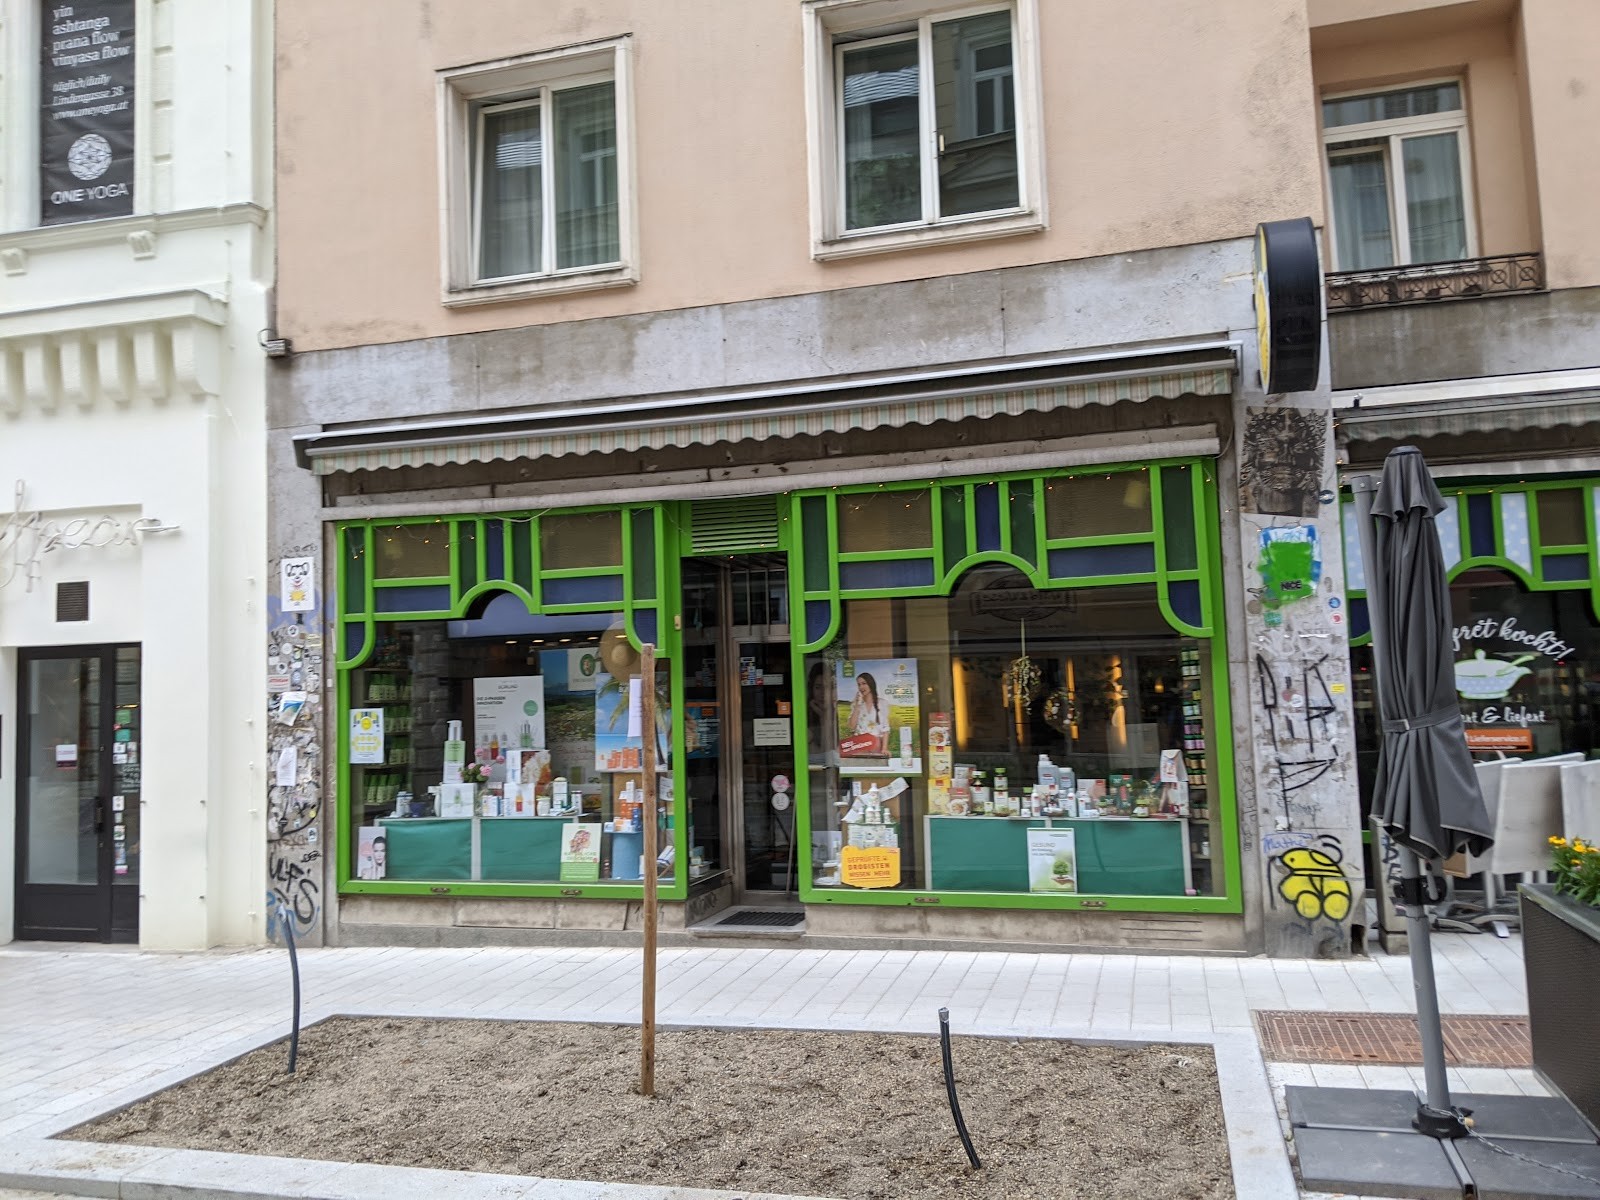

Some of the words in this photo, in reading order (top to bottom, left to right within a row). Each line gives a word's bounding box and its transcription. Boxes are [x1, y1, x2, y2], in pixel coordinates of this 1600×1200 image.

[53, 5, 73, 21] yin
[52, 16, 110, 35] ashtanga
[52, 36, 90, 54] prana
[91, 30, 120, 45] flow
[52, 50, 100, 67] vinyasa
[102, 45, 131, 59] flow
[51, 189, 84, 205] ONE
[86, 183, 129, 201] YOGA
[1499, 617, 1576, 661] kocht!
[1480, 706, 1502, 724] &
[1503, 706, 1547, 728] liefert
